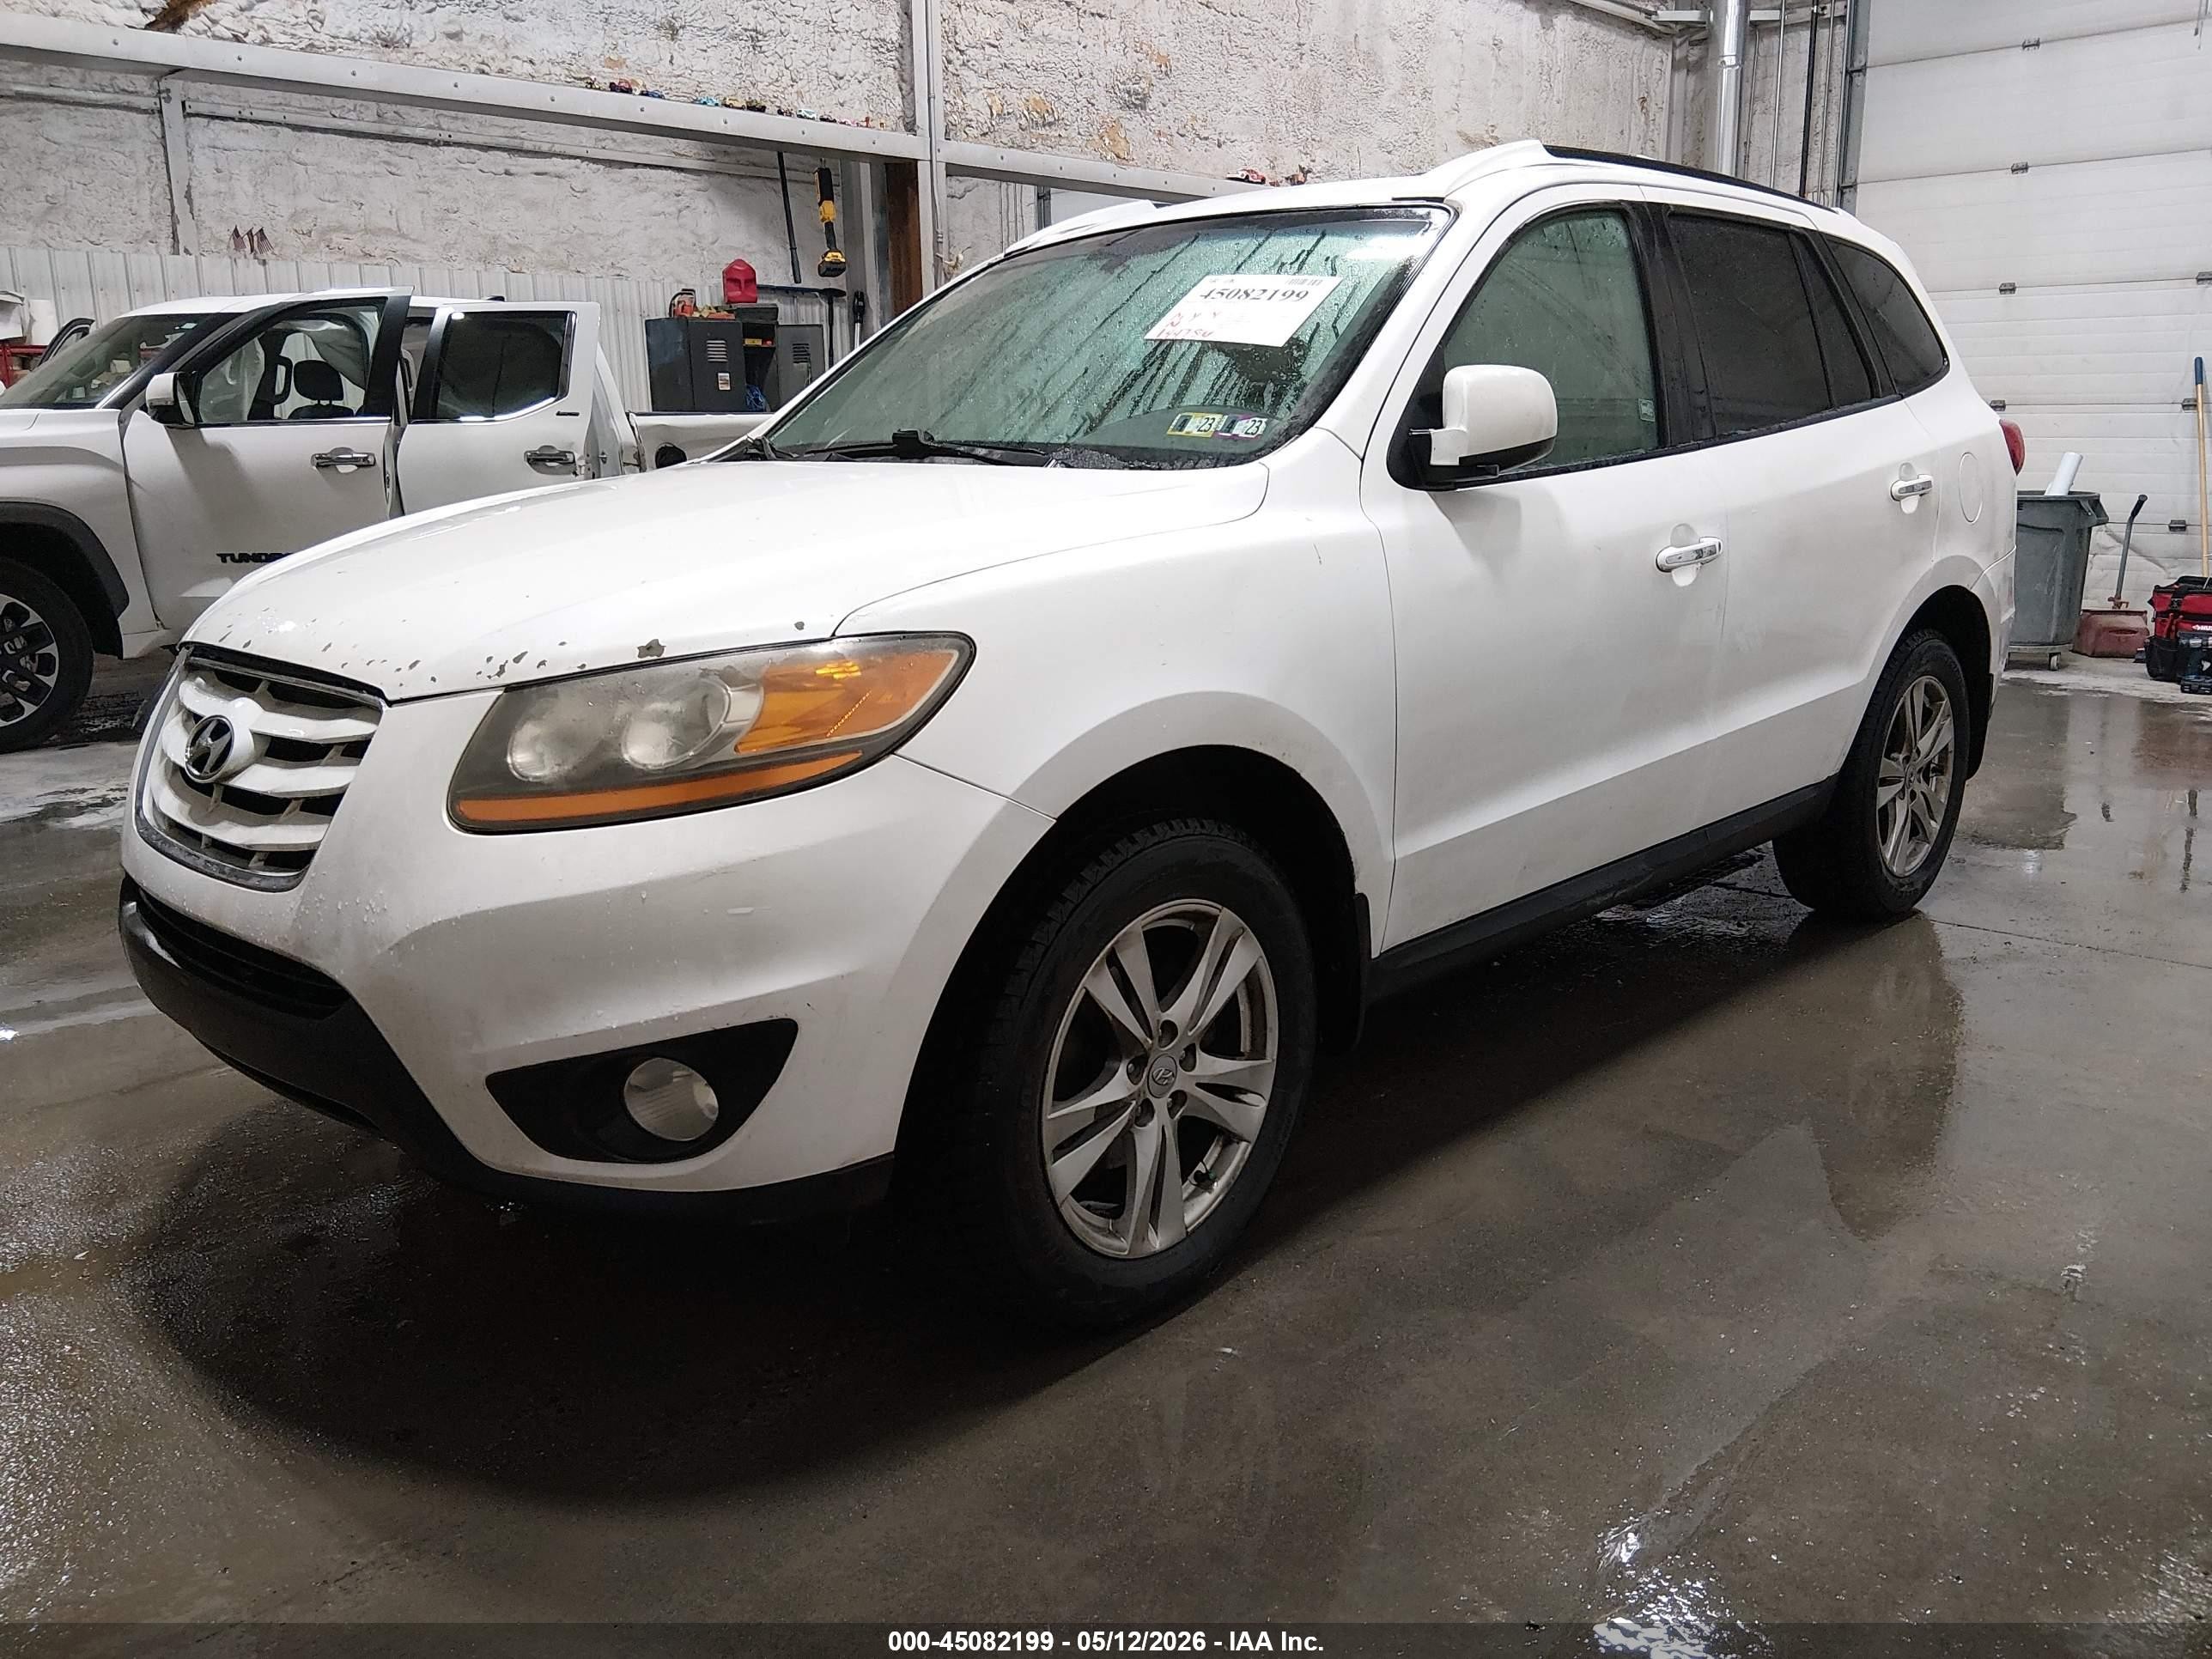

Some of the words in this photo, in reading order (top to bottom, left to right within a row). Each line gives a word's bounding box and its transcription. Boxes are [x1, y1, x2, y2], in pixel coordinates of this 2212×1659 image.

[1200, 288, 1310, 301] 45082199
[1178, 418, 1189, 432] 4
[1197, 417, 1216, 433] 23
[1226, 419, 1237, 433] 4
[1244, 419, 1263, 435] 23
